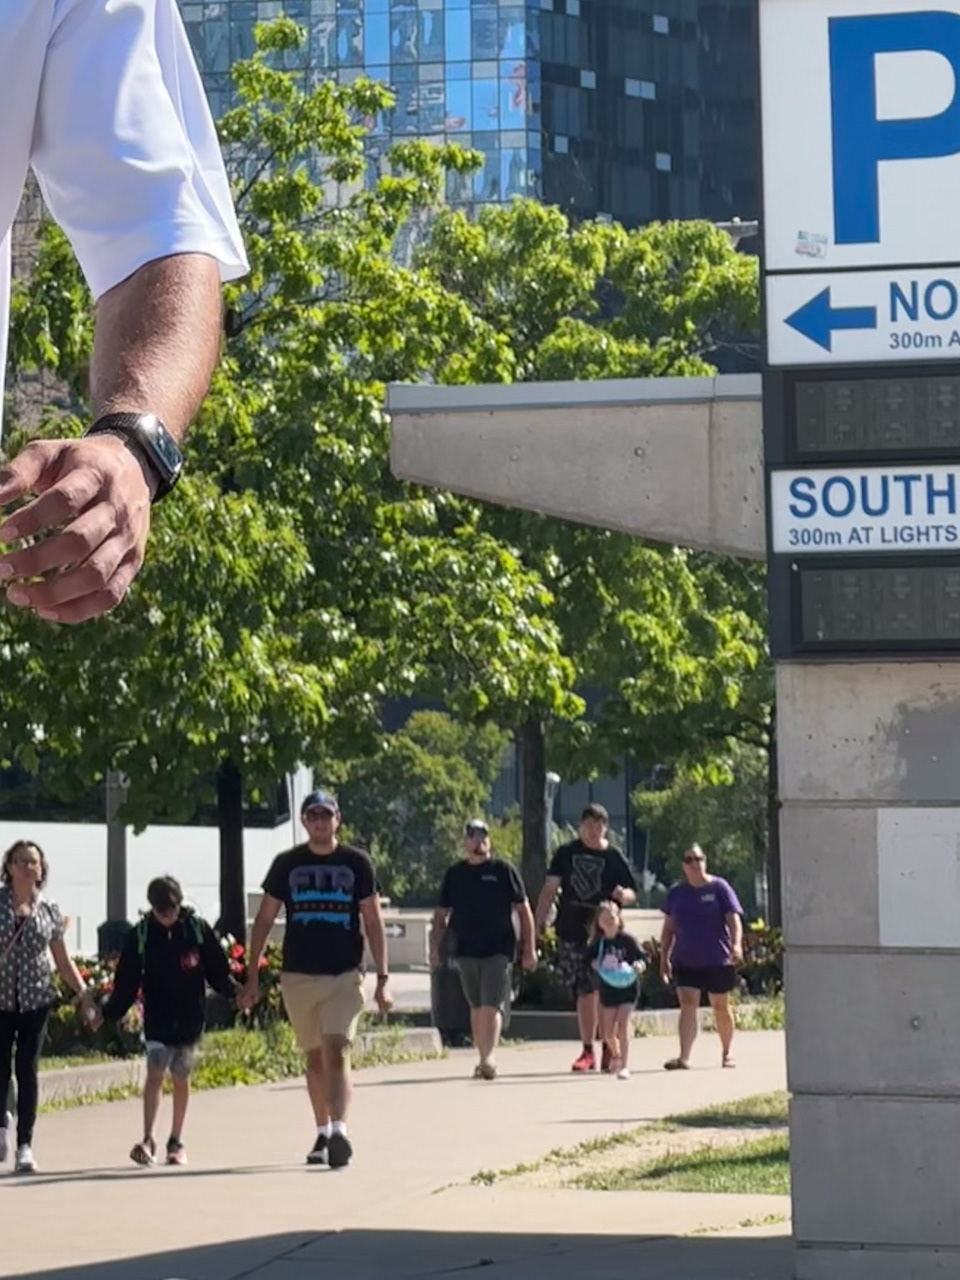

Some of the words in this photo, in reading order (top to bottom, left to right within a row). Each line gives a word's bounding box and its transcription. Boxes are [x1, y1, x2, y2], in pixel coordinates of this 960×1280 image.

[828, 10, 960, 244] P
[890, 279, 958, 322] NO
[889, 331, 942, 349] 300m
[789, 473, 957, 518] SOUTH
[789, 528, 841, 545] 300m
[848, 526, 874, 544] AT
[881, 524, 958, 543] LIGHTS
